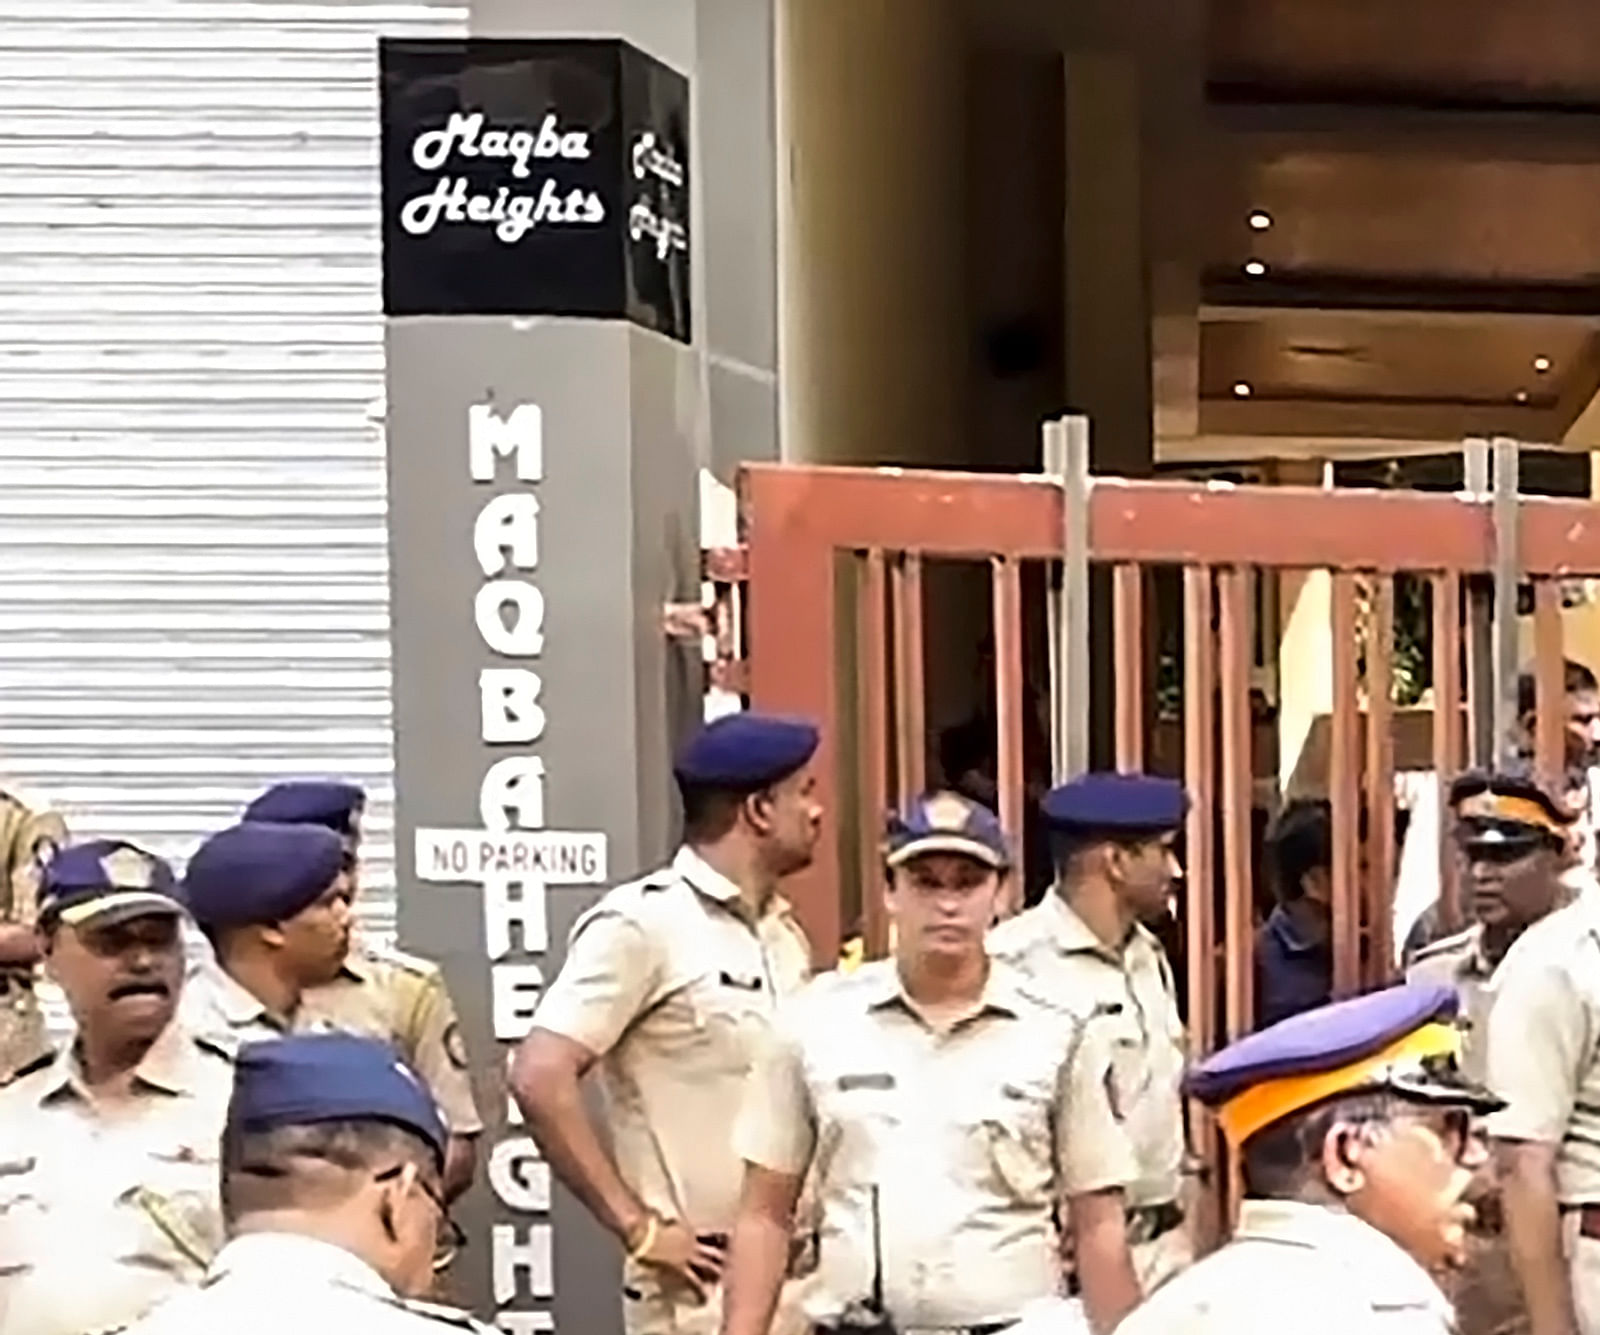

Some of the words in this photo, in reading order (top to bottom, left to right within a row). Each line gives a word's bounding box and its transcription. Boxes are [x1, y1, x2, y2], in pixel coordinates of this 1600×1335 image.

[413, 113, 590, 178] Maqba
[401, 177, 605, 243] Heights
[469, 404, 546, 829] MAQBA
[433, 842, 468, 873] NO
[479, 841, 597, 876] PARKING
